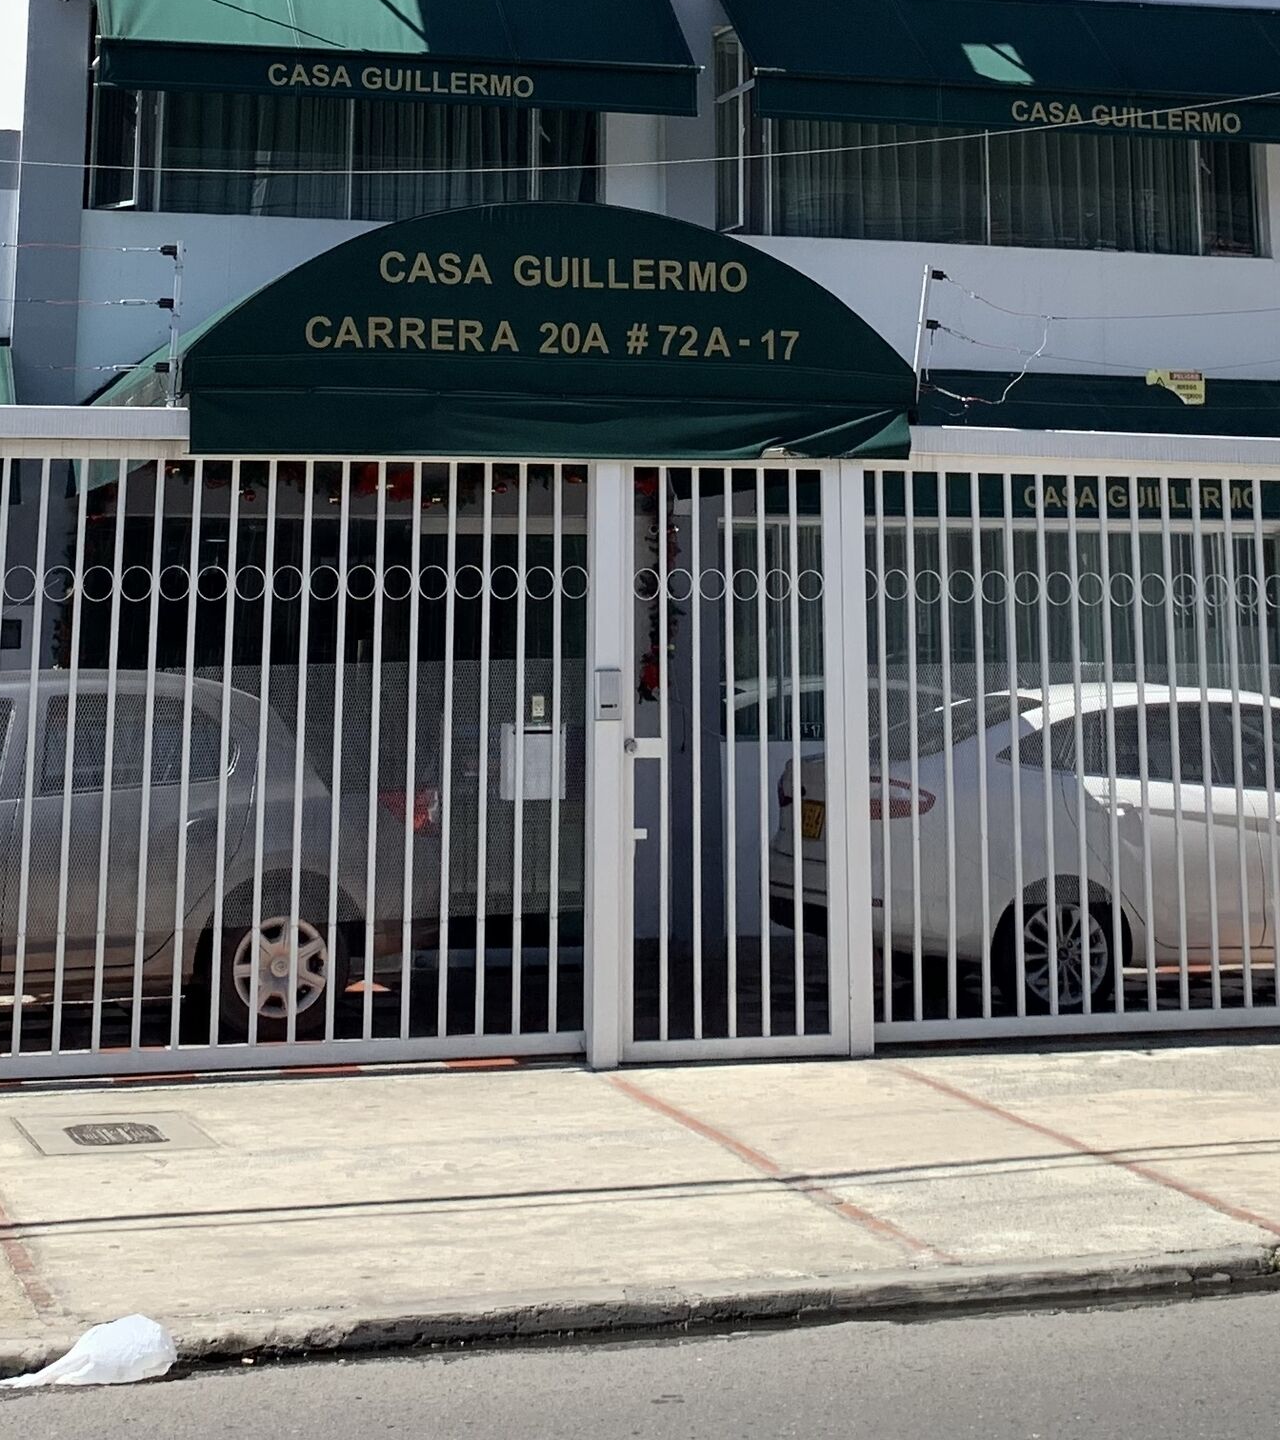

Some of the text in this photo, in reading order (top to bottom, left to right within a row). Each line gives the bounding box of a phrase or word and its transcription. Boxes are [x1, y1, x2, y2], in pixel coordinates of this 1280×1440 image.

[268, 63, 535, 98] CASA GUILLERMO
[1011, 100, 1242, 134] CASA GUILLERMO
[380, 251, 748, 294] CASA GUILLERMO
[305, 316, 519, 353] CARRERA
[539, 322, 609, 354] 20A
[1023, 485, 1097, 508] CASA
